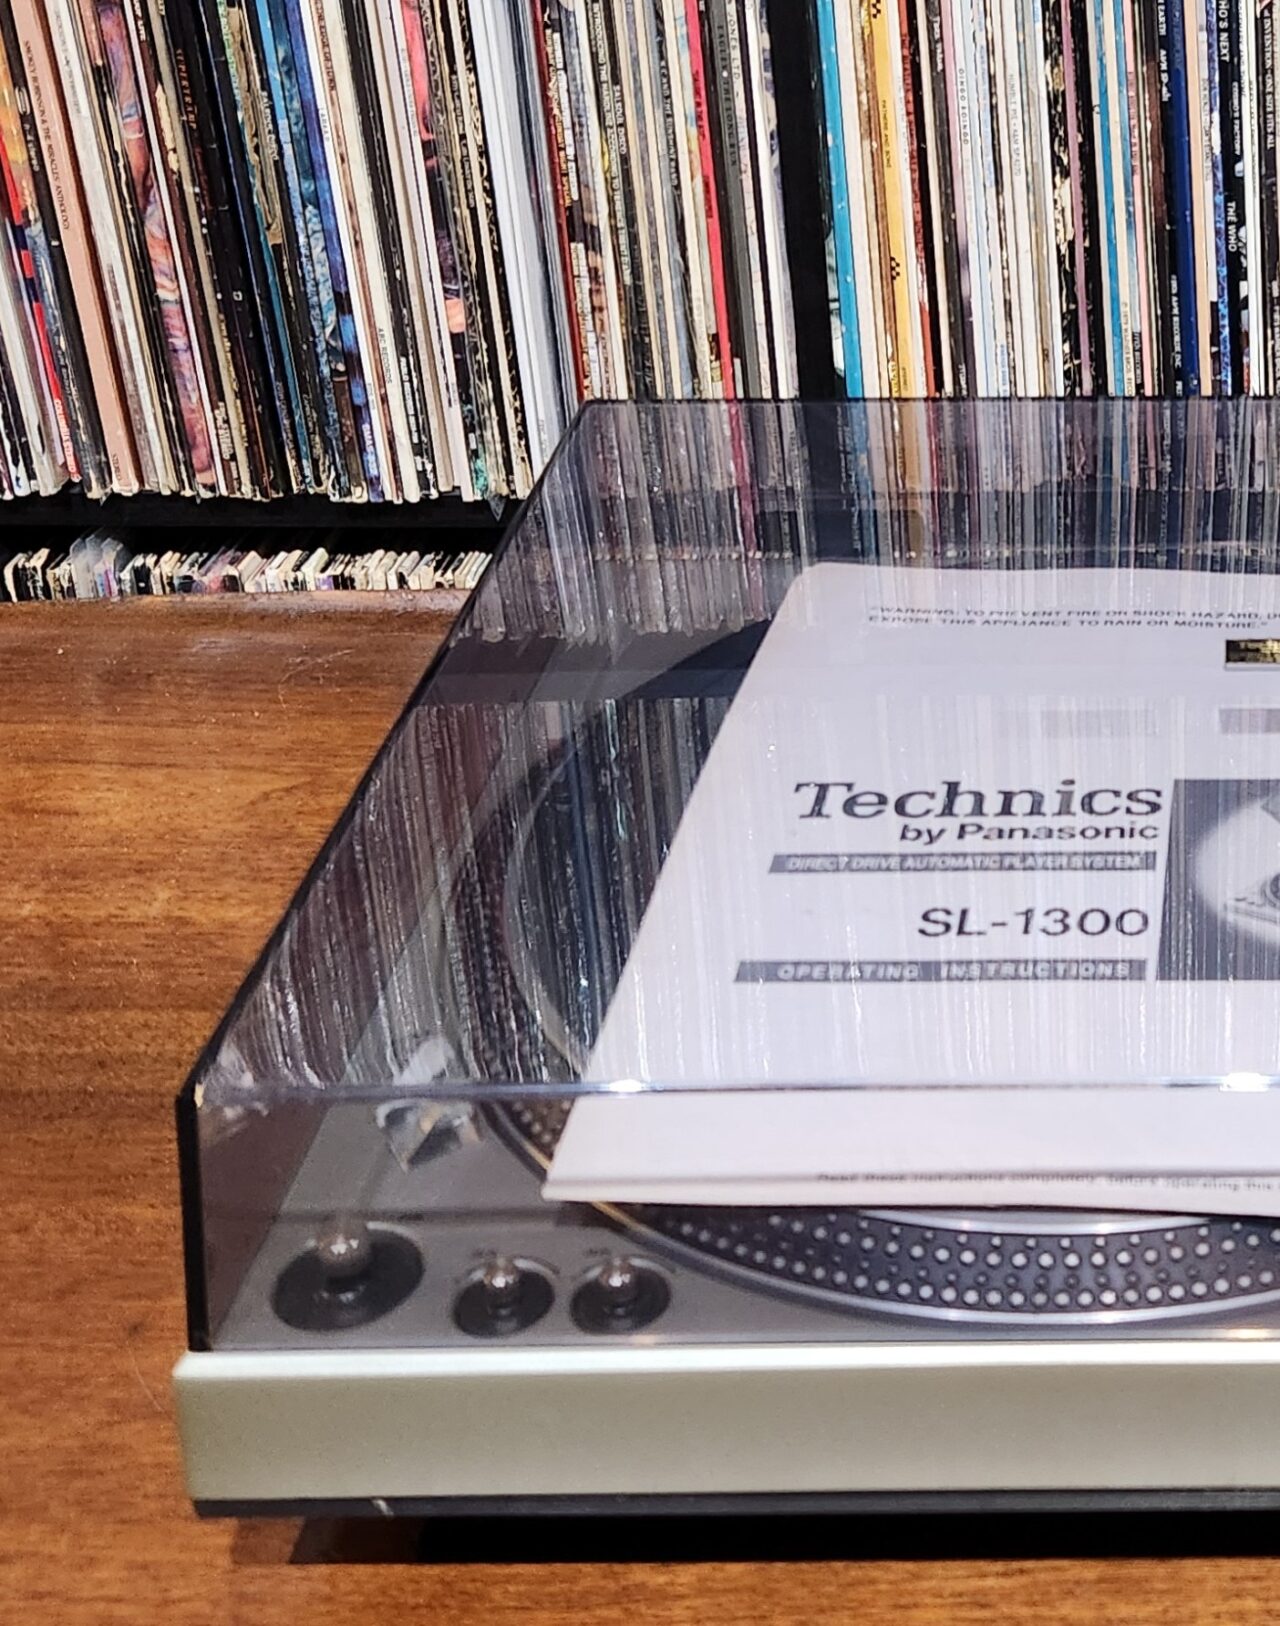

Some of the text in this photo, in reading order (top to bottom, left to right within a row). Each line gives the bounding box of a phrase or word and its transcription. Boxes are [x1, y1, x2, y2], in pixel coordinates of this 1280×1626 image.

[591, 3, 606, 63] INTRODUCING
[727, 12, 738, 50] JONES
[1157, 5, 1166, 35] EARTH
[1217, 0, 1230, 62] HO'S NEXT
[598, 65, 608, 81] THE
[612, 84, 623, 124] SALSOUL
[716, 25, 737, 166] EAGLES THE LONG RUN
[957, 68, 969, 144] OINGO BOINGO
[23, 40, 36, 73] SMOKEY
[31, 76, 46, 117] ROBINSON
[42, 127, 51, 140] THE
[54, 185, 70, 229] ANTHOLOGY
[1233, 119, 1241, 154] FACTORY
[1266, 135, 1274, 148] ALL
[611, 179, 620, 190] TO
[1226, 201, 1237, 251] THE WHO
[377, 327, 392, 383] ABC RECORDS
[868, 615, 930, 624] EXPOSE
[942, 618, 976, 626] THIS
[981, 618, 1072, 627] APPLIANCE
[965, 608, 985, 616] TO
[990, 608, 1063, 617] PREVENT
[1068, 609, 1101, 617] FIRE
[1132, 610, 1188, 618] SHOCK
[794, 778, 1162, 819] Technics
[899, 821, 1160, 845] by Panasonic
[786, 853, 1142, 872] DIRECT DRIVE AUTOMATIC PLAYER SYSTEM
[917, 907, 1151, 938] SL-1300
[776, 961, 1131, 981] OPERATING INSTRUCTIONS
